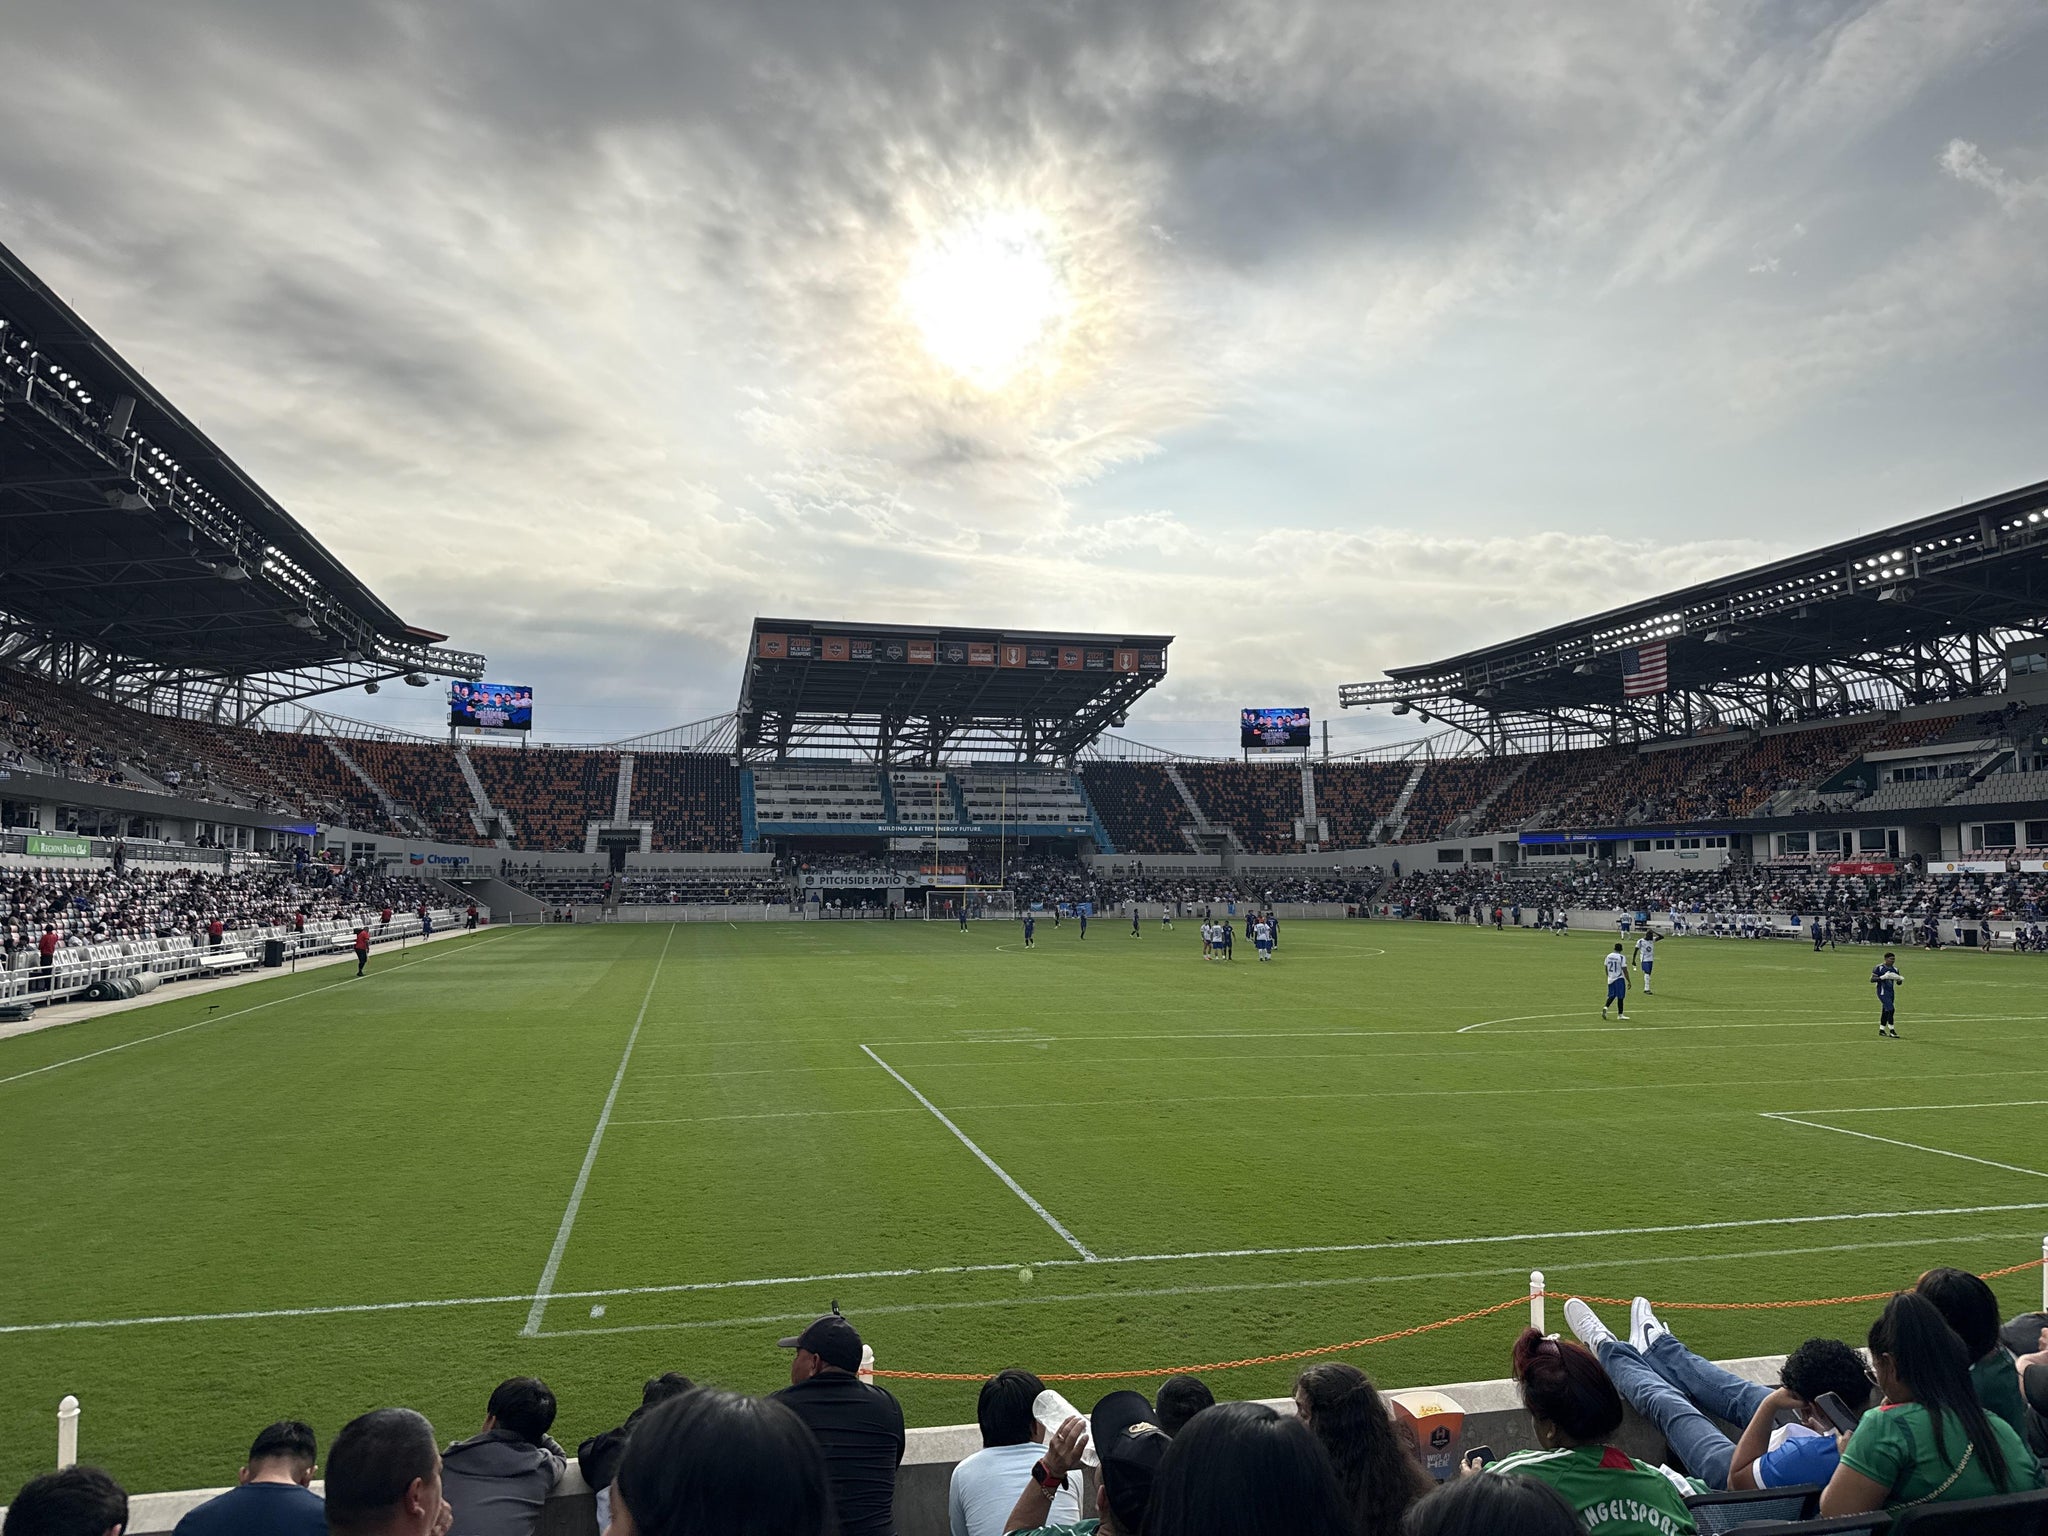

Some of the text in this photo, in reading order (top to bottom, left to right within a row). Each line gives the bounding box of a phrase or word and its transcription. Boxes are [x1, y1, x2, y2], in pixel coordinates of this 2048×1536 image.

[427, 854, 470, 864] Chevron
[820, 876, 901, 885] PITCHSIDE PATIO
[1607, 961, 1617, 973] 21
[1583, 1499, 1680, 1536] NGEL'SPORT
